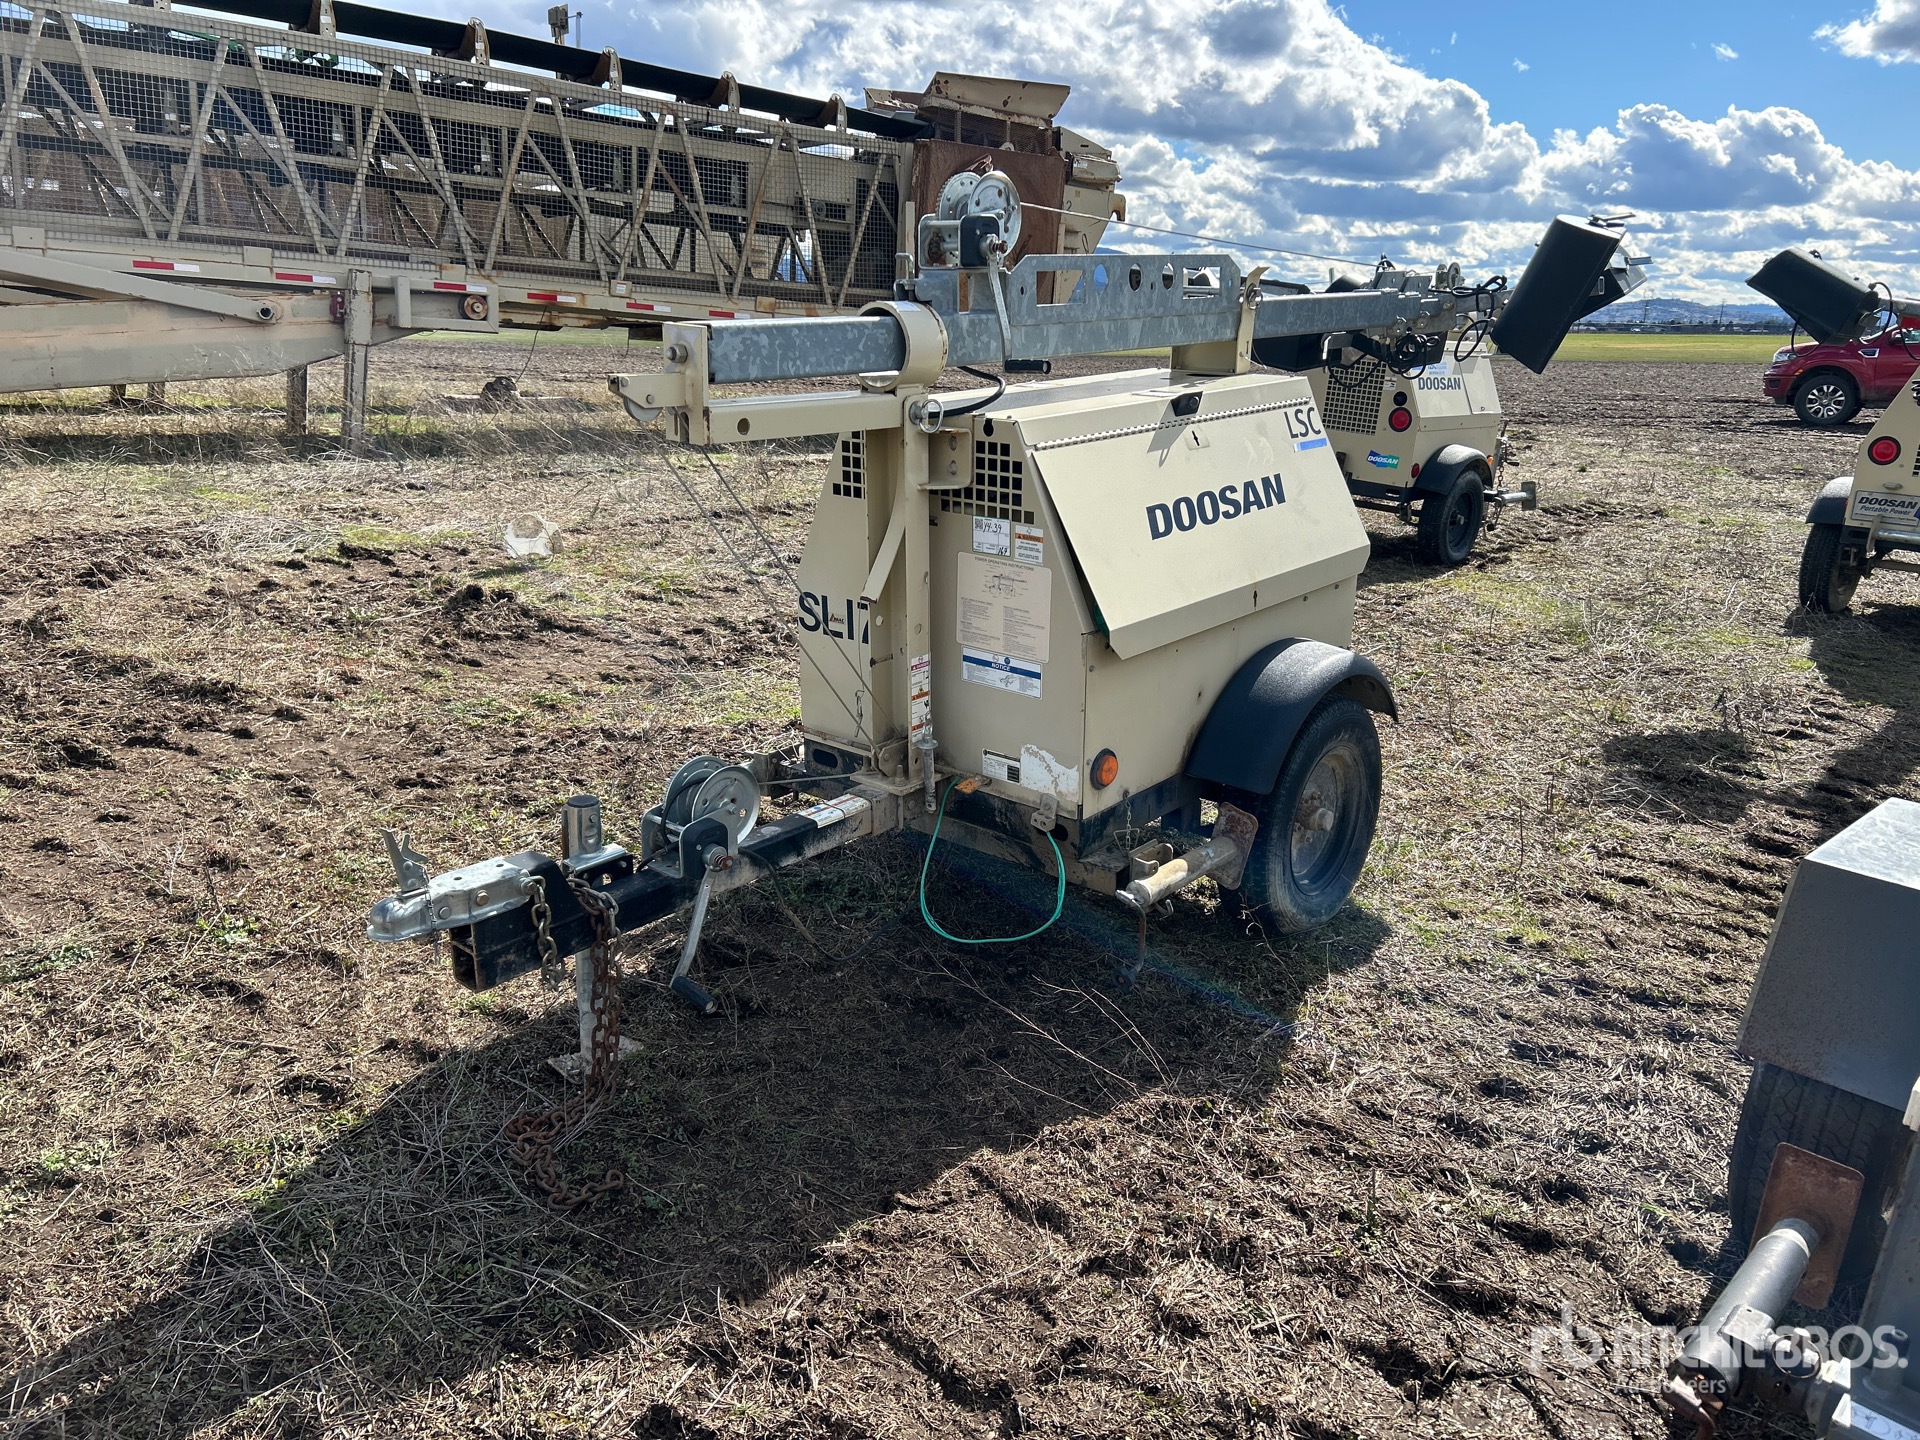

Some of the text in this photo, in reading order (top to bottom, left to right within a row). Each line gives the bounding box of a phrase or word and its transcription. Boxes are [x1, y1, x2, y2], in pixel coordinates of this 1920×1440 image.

[1418, 377, 1461, 390] DOOSAN
[1284, 407, 1322, 439] LSC
[1367, 455, 1399, 465] DOOSAN
[1145, 472, 1287, 541] DOOSAN
[1858, 496, 1919, 510] DOOSAN
[1860, 504, 1912, 516] Portable Power
[987, 557, 1008, 567] OPERATING
[1008, 562, 1035, 572] INSTRUCTIONS
[991, 662, 1011, 672] NOTICE
